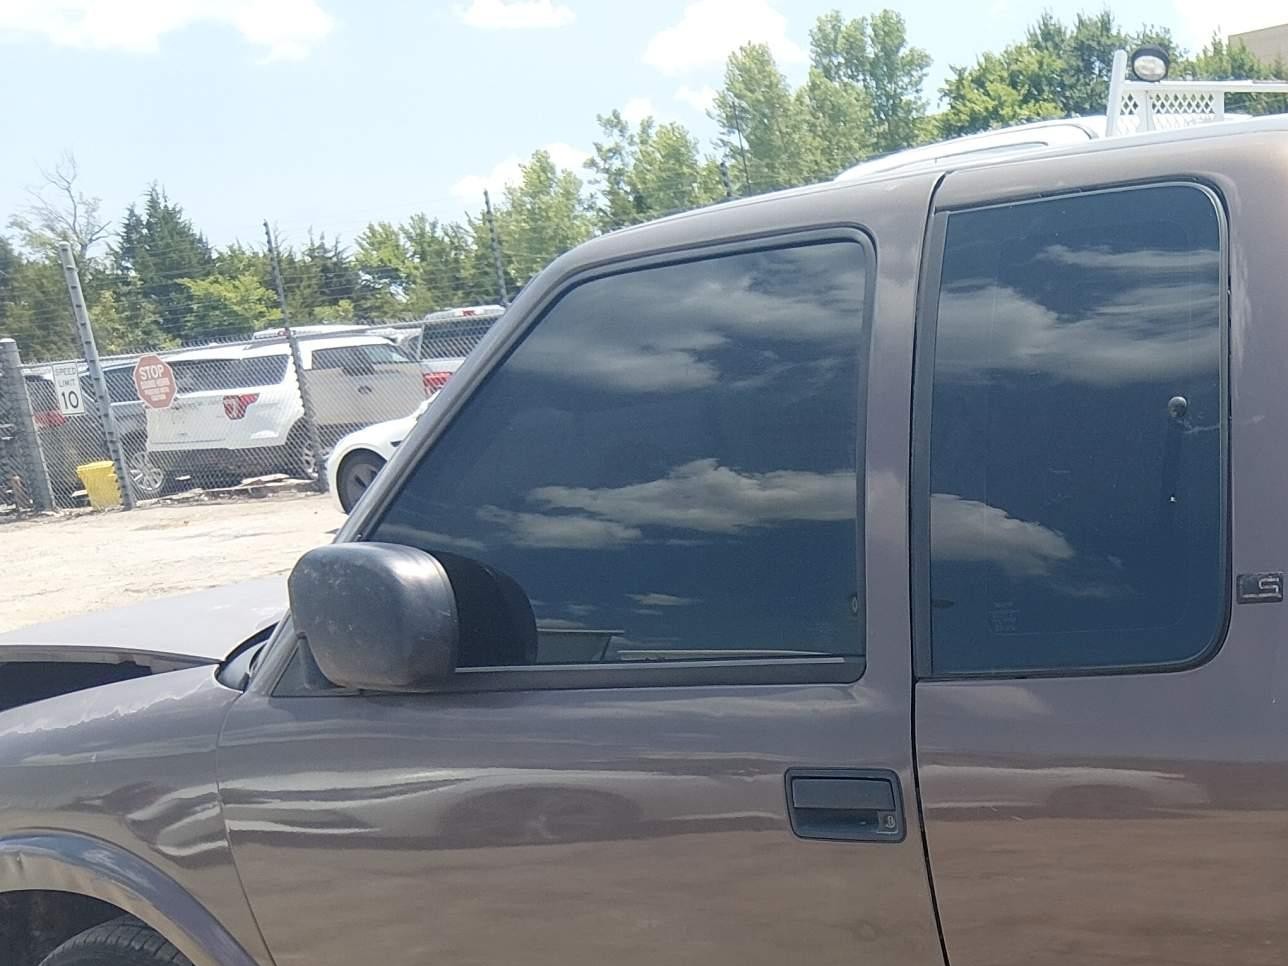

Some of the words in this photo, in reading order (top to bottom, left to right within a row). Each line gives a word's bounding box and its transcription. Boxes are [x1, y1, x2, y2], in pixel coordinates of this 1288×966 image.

[55, 367, 76, 376] SPEED
[139, 364, 164, 380] STOP
[58, 378, 76, 388] LIMIT
[61, 390, 79, 409] 10
[1240, 577, 1282, 599] LS
